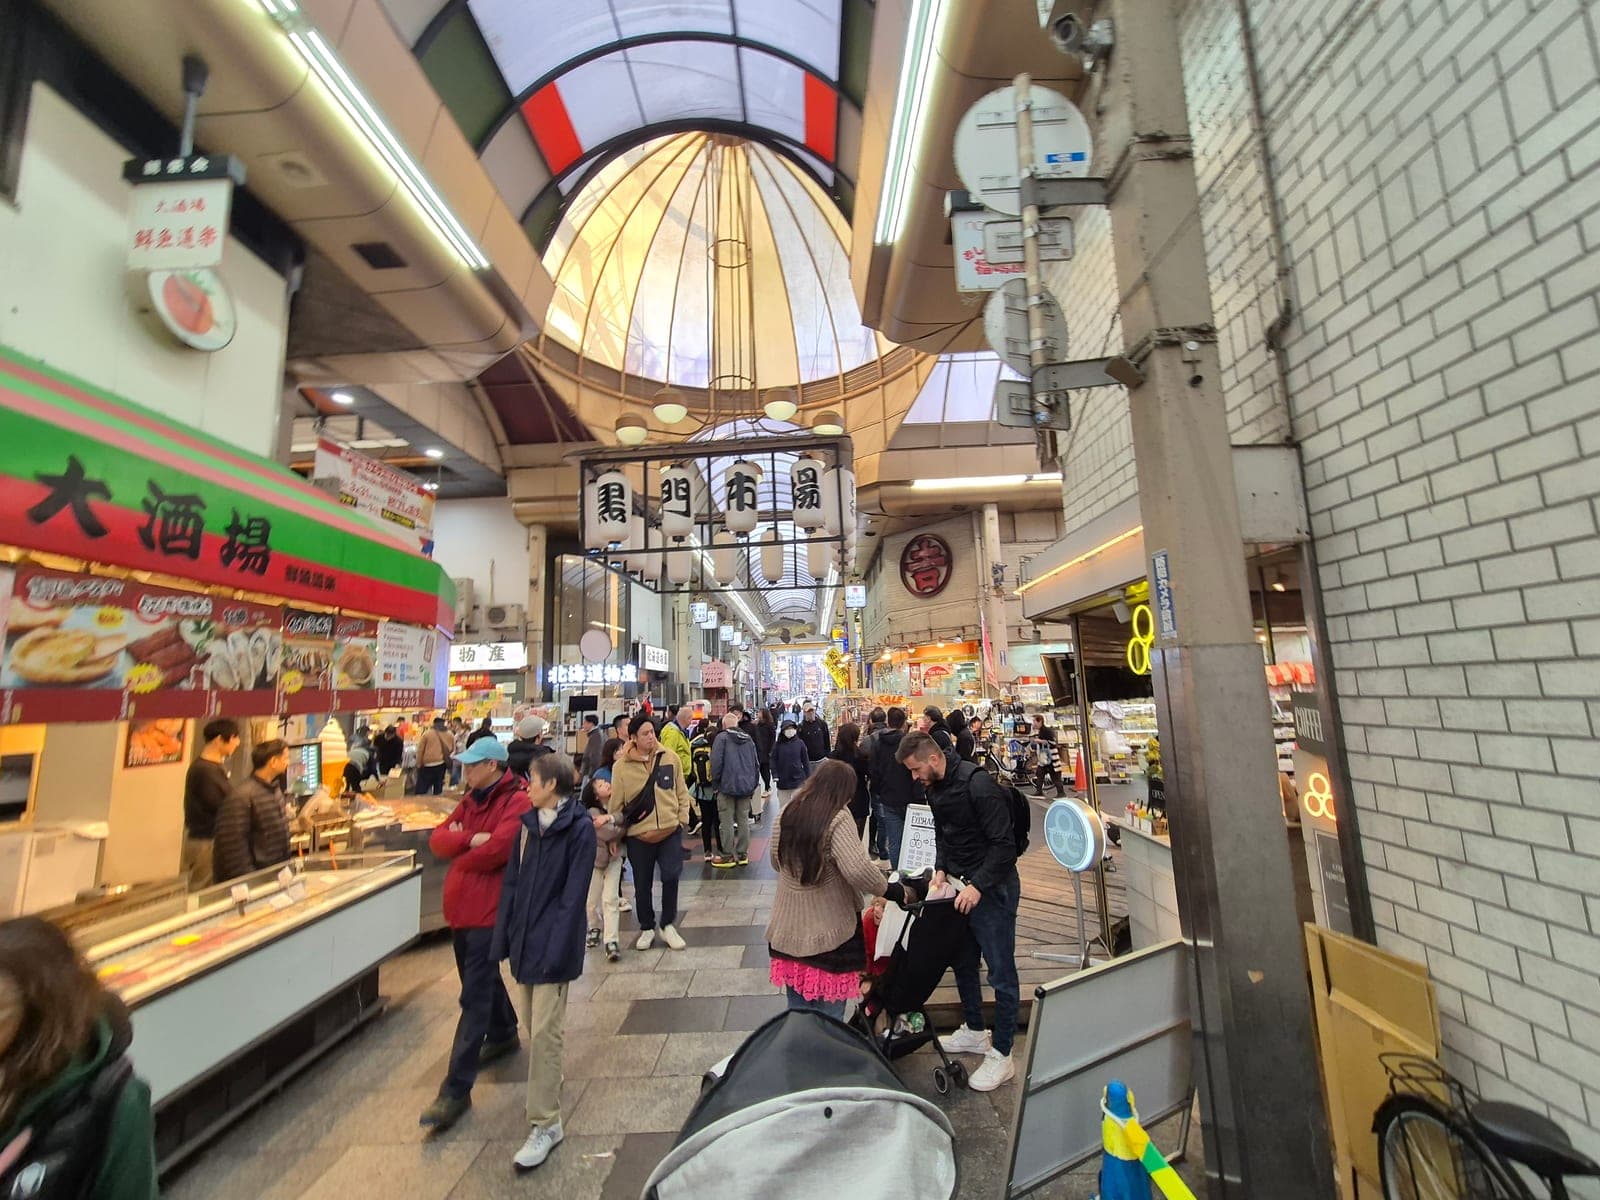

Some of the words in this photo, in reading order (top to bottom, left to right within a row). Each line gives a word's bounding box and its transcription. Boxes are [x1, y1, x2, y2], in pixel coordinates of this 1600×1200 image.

[27, 454, 273, 576] 大酒場
[598, 466, 821, 525] 黒門市場
[879, 695, 903, 705] SALE
